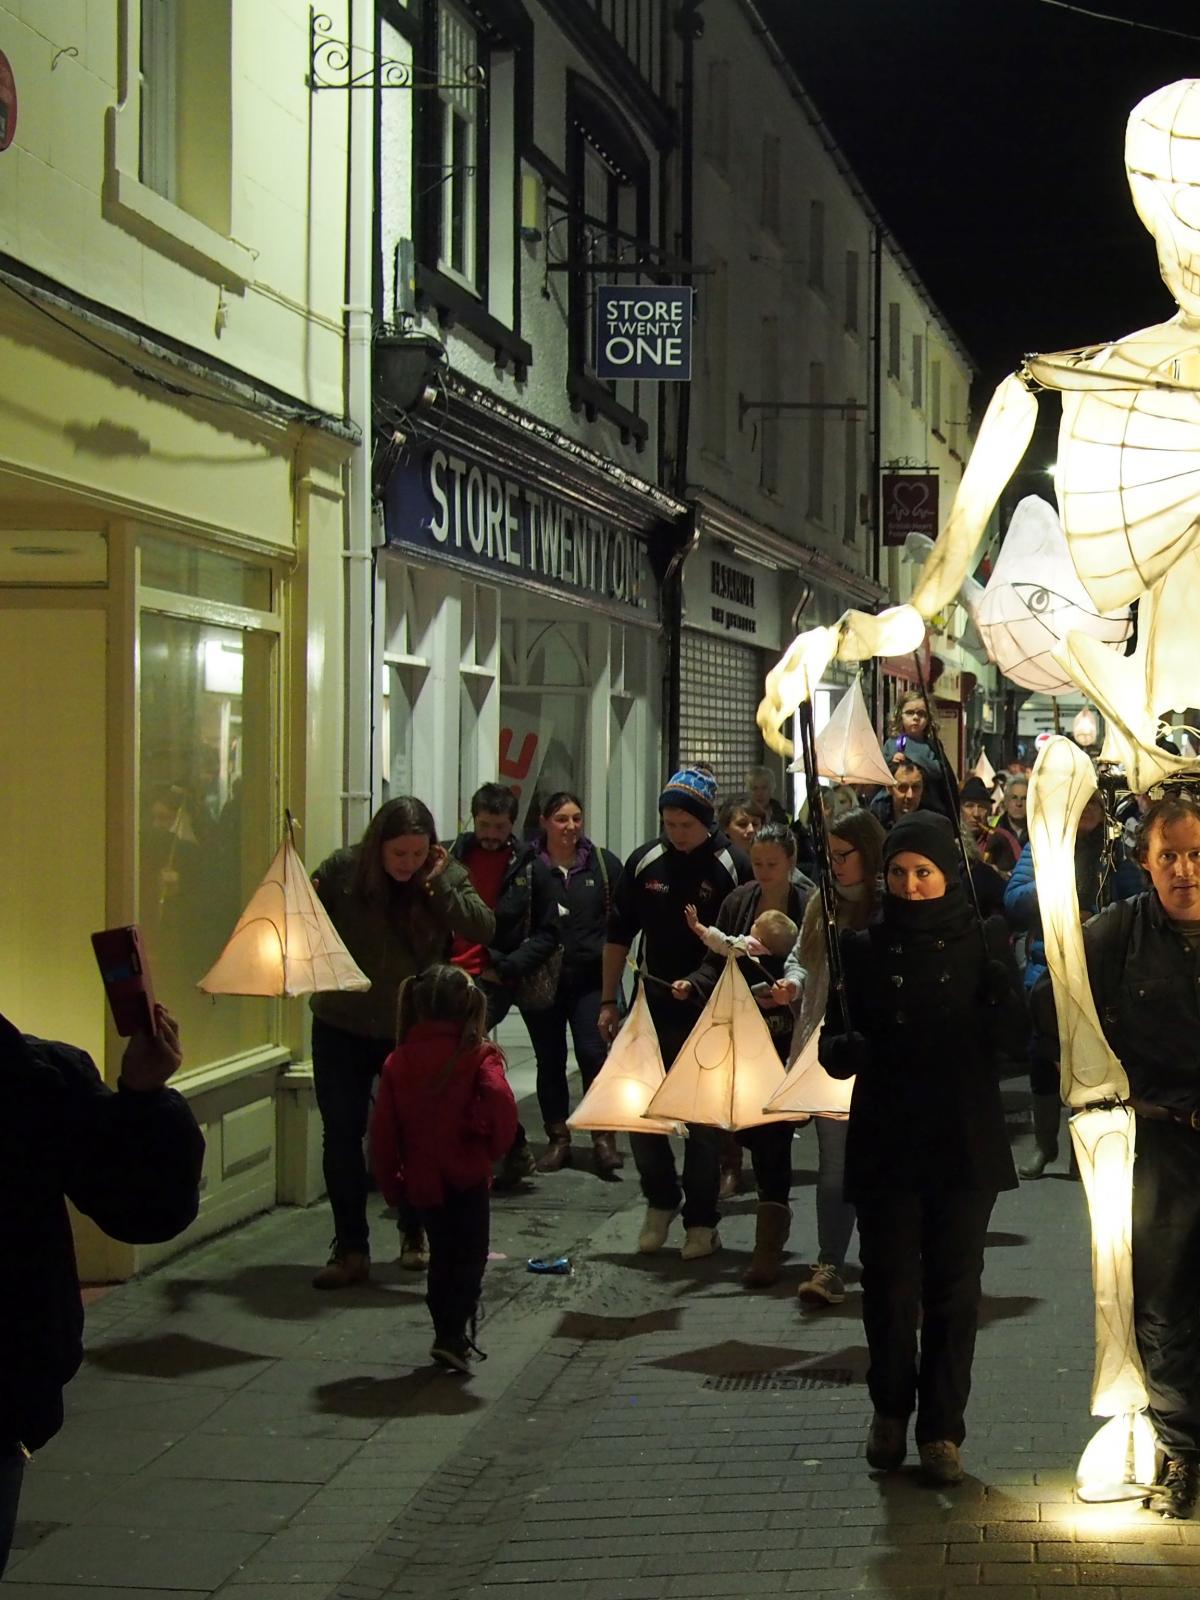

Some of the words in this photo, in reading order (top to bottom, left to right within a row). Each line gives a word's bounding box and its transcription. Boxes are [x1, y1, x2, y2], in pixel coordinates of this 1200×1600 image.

[606, 300, 683, 320] STORE
[606, 321, 682, 336] TWENTY
[605, 336, 682, 366] ONE
[431, 450, 521, 566] STORE
[525, 489, 610, 594] TWENTY
